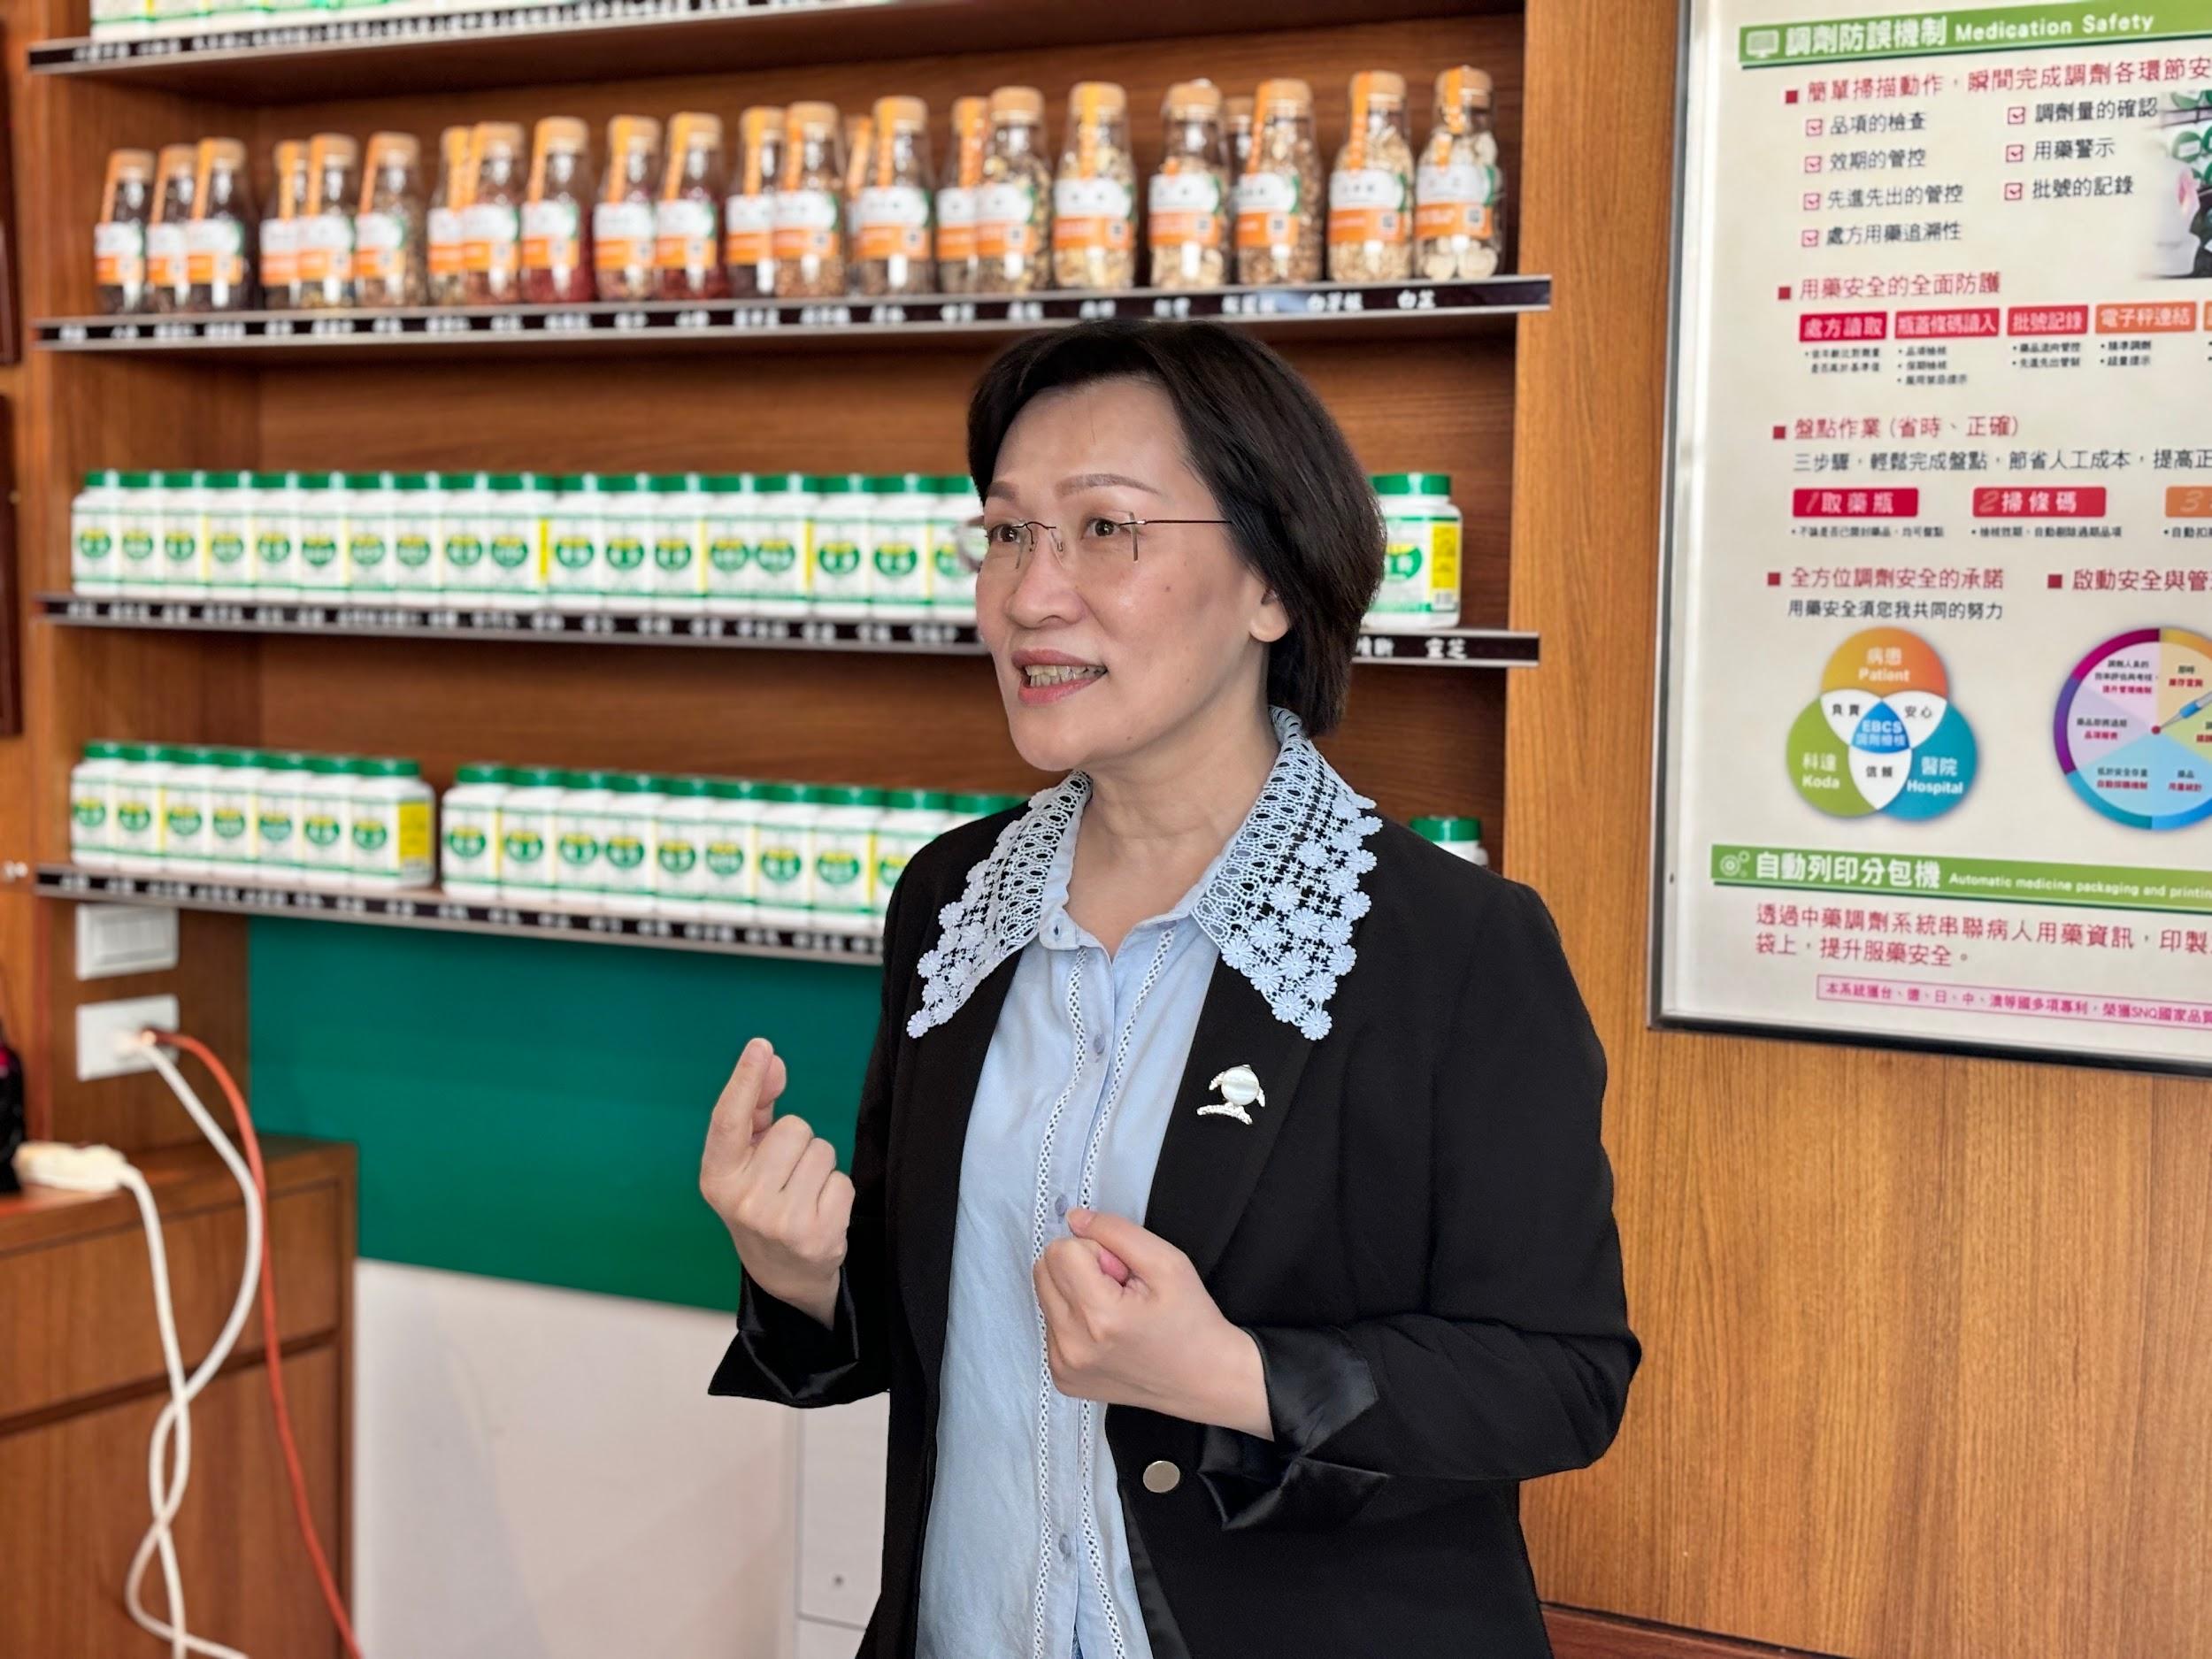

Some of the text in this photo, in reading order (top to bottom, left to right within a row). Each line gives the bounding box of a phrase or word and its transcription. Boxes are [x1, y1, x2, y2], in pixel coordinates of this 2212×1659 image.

[1786, 13, 2154, 57] 調劑防誤機制 Medication Safety
[2035, 97, 2158, 122] 調劑量的確認
[1830, 111, 1926, 134] 品項的檢查
[1830, 148, 1926, 171] 效期的管控
[2033, 137, 2116, 160] 用藥警示
[1827, 184, 1963, 209] 先進先出的管控
[2032, 175, 2133, 199] 批號的記錄
[1800, 272, 2001, 300] 用藥安全的全面防護
[1791, 567, 2004, 589] 全方位調劑安全的承諾
[2073, 569, 2212, 591] 啟動安全與管
[1787, 599, 2003, 619] 用藥安全須您我共同的努力
[1858, 668, 1911, 683] Patient
[1904, 705, 1932, 718] 安心
[1861, 719, 1903, 734] EBCS
[1921, 756, 1958, 777] 醫院
[1801, 774, 1840, 789] Koda
[1907, 780, 1964, 795] Hospital
[1756, 851, 1941, 890] 自動列印分包機
[1949, 872, 2012, 888] Automatic
[2016, 878, 2072, 892] medicine
[2076, 880, 2139, 897] packaging
[2143, 885, 2166, 897] and
[1756, 902, 2212, 955] 透過中藥調劑系統串聯病人用藥資訊，印製
